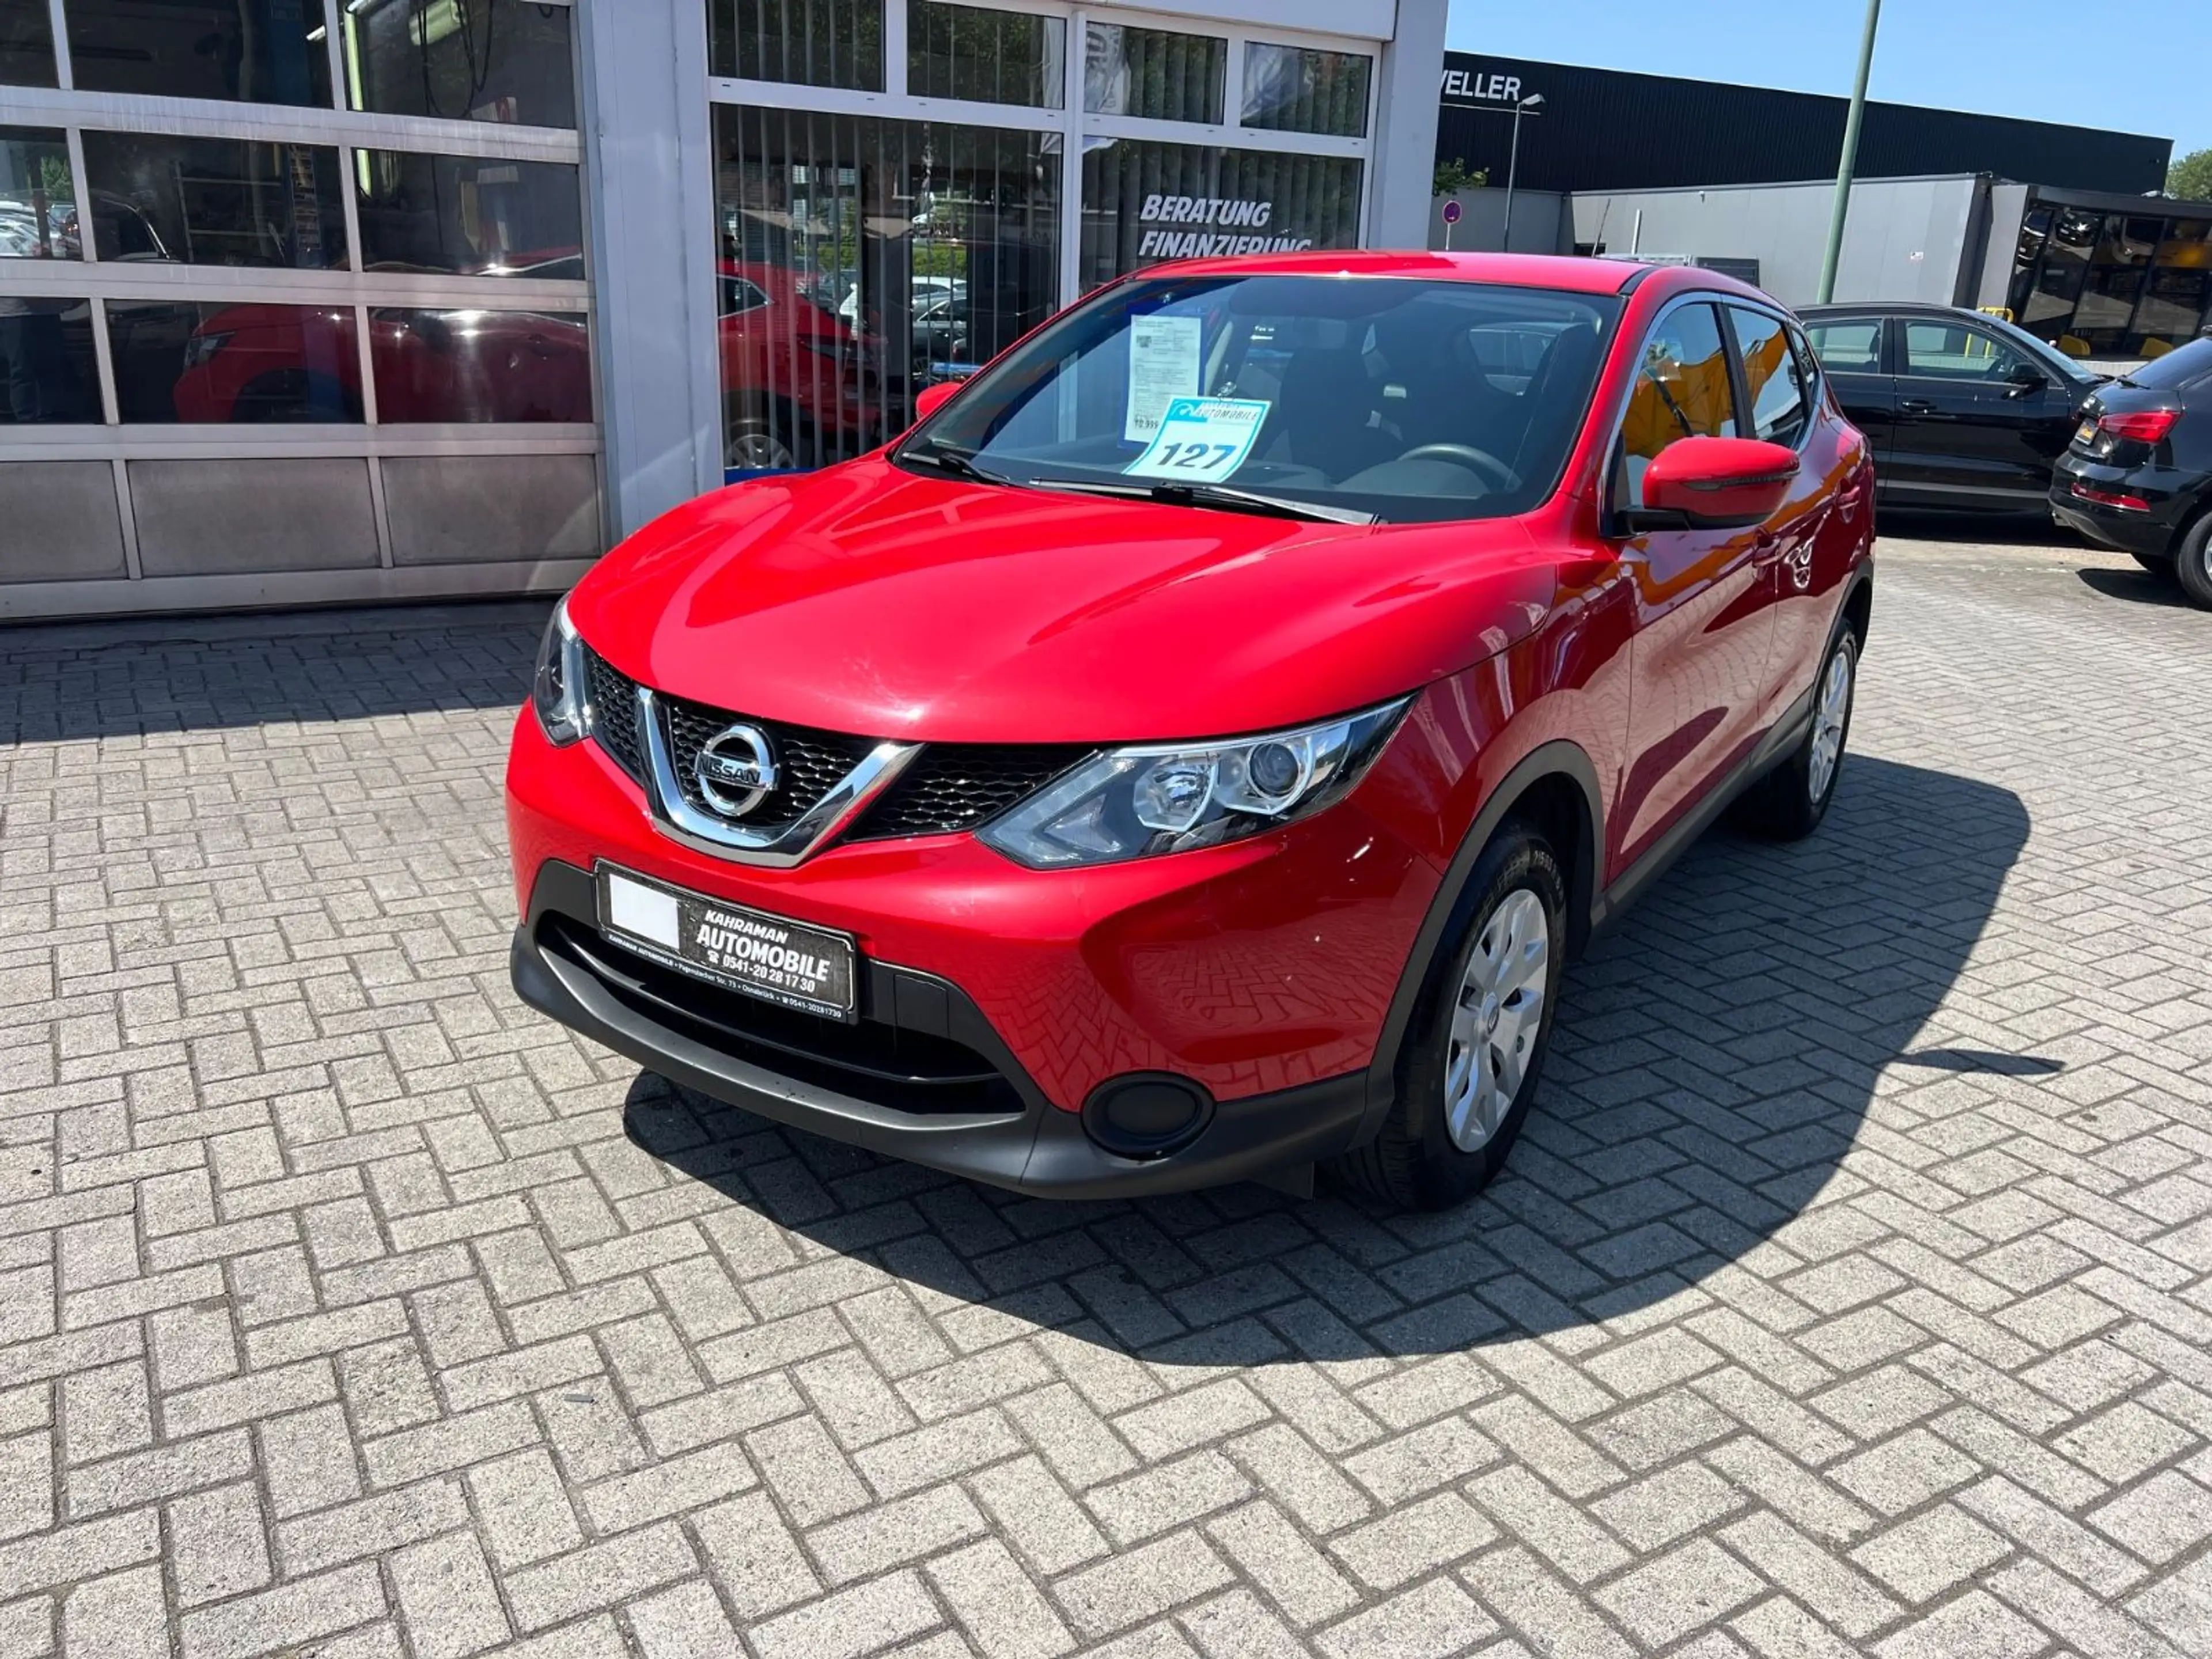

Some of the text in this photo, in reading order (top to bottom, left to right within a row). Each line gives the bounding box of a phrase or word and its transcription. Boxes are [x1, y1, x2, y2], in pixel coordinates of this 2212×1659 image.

[1140, 194, 1272, 228] BERATUNG
[1157, 442, 1237, 469] 127
[698, 754, 760, 783] NISSAN
[704, 909, 789, 944] KAHRAMAN
[696, 923, 831, 982] AUTOMOBILE
